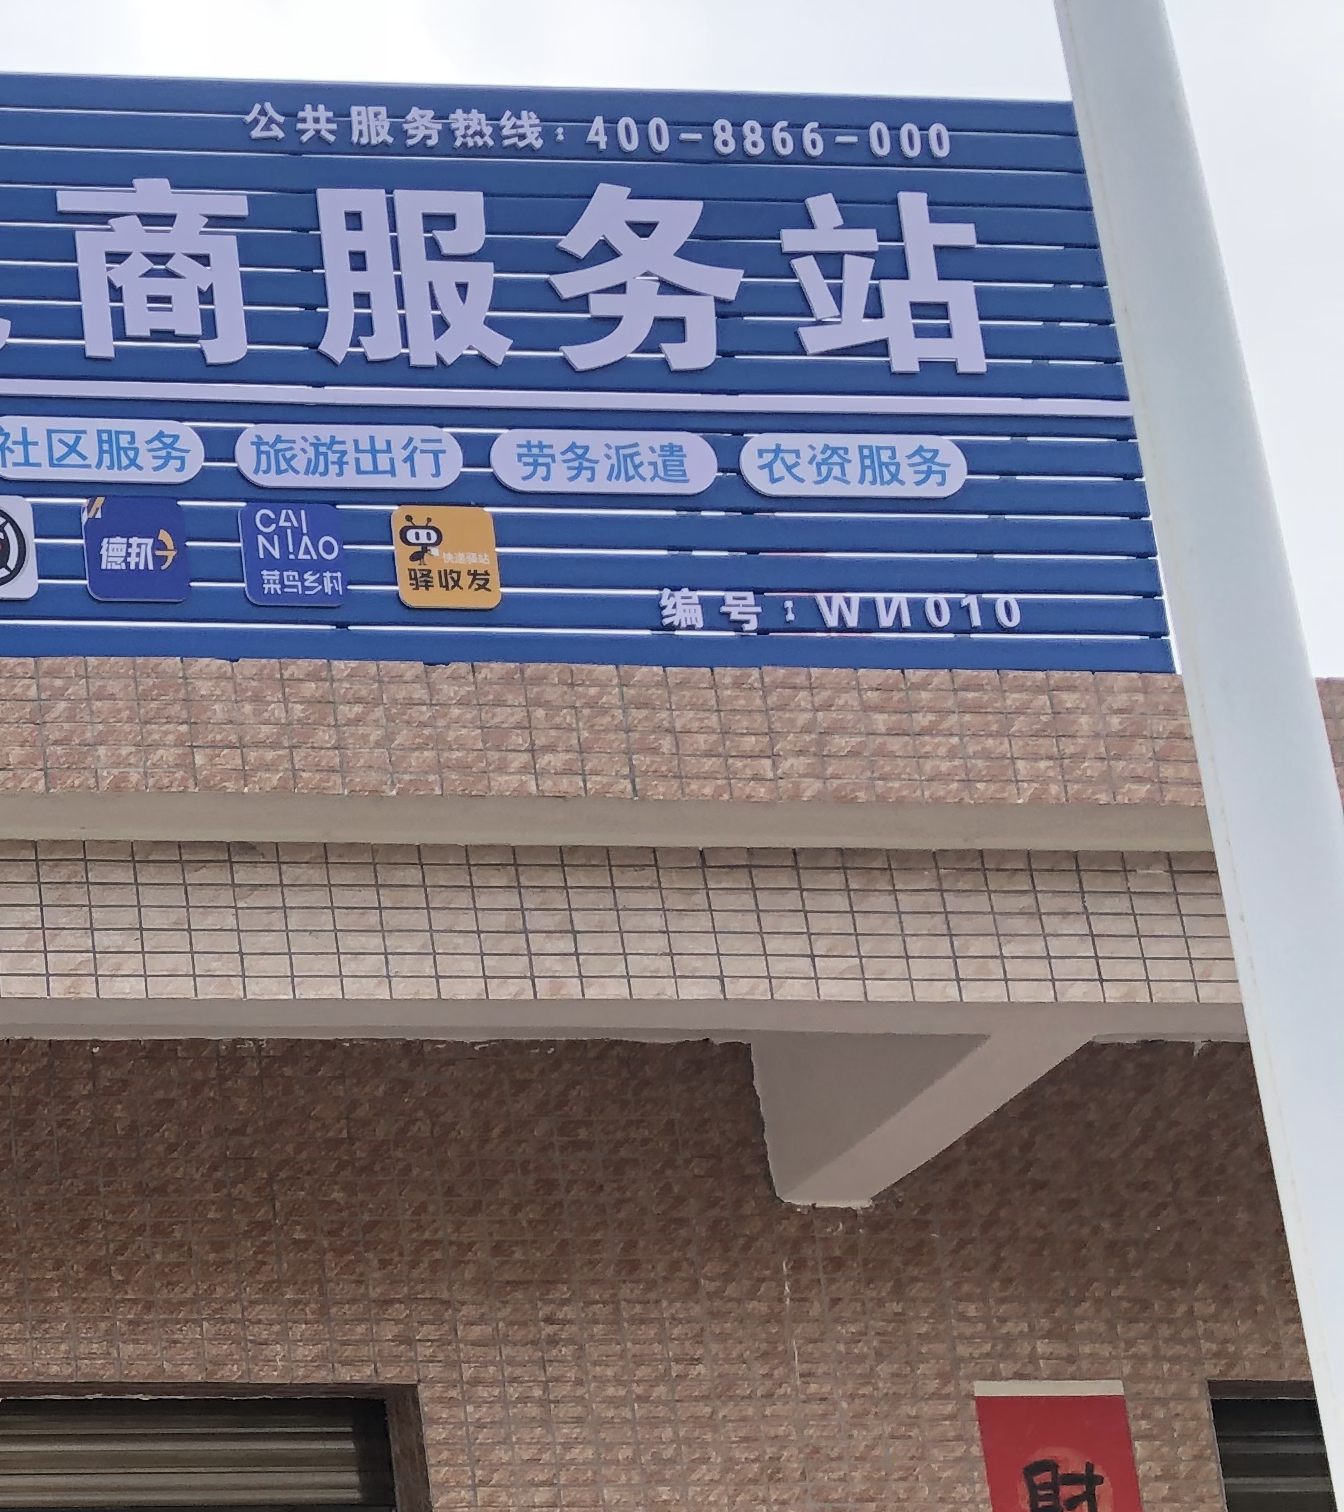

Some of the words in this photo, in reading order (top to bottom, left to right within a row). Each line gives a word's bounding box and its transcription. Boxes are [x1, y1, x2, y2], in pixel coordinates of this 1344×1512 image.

[250, 432, 447, 481] 旅游出行
[514, 439, 691, 486] 劳务派遣
[755, 442, 952, 490] 农资服务
[255, 508, 308, 534] CAI
[99, 536, 155, 571] 德邦
[260, 569, 343, 596] 菜鸟乡村
[407, 567, 493, 593] 驿收发
